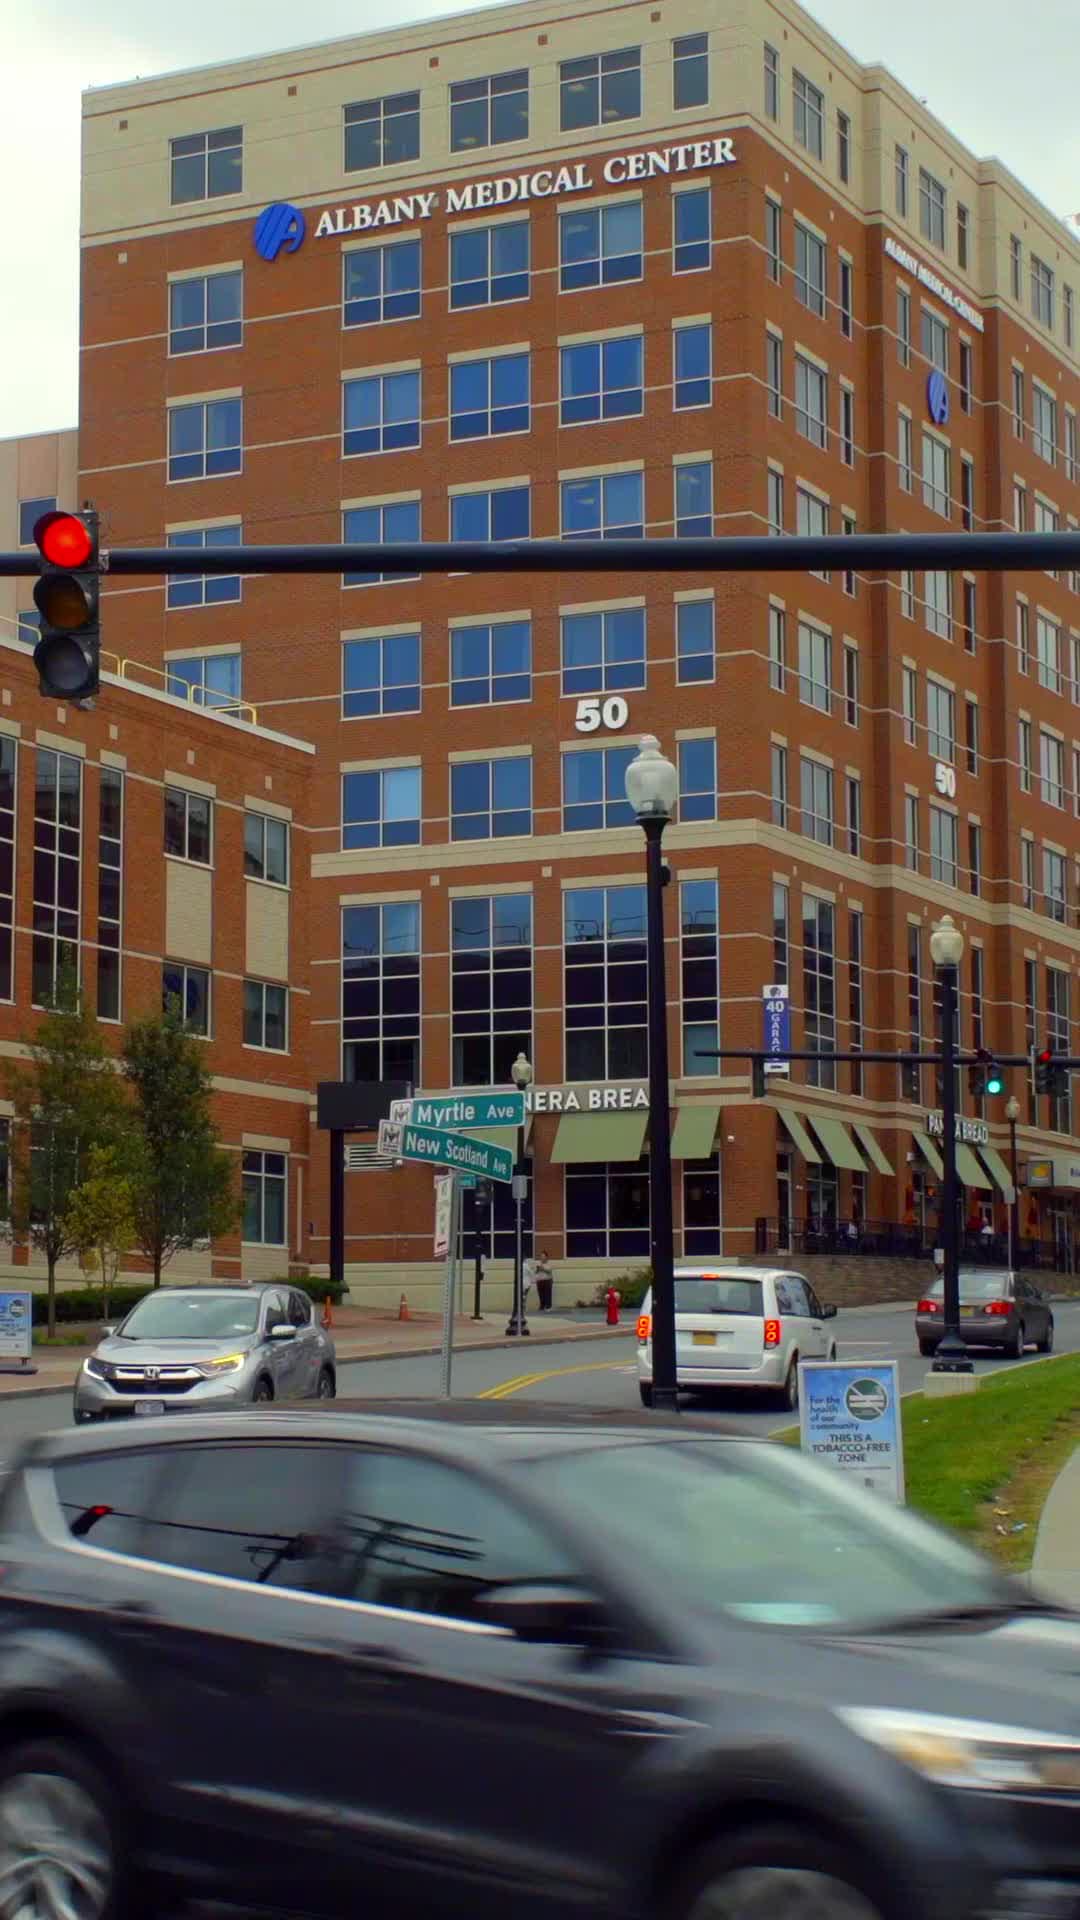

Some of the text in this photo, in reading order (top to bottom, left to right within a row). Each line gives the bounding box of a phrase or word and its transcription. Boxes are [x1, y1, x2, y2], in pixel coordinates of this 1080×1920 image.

[314, 137, 737, 238] ALBANY MEDICAL CENTER
[575, 696, 629, 732] 50
[935, 762, 956, 798] 50
[766, 1001, 785, 1013] 40
[770, 1013, 781, 1061] GARAG
[524, 1087, 650, 1111] NERA BREA
[417, 1102, 515, 1127] Myrtle Ave
[962, 1121, 989, 1143] BREAD
[406, 1132, 507, 1174] New Scotland Ave
[812, 1443, 891, 1453] TOBACCO-FREE
[830, 1433, 872, 1442] THIS IS A
[838, 1453, 866, 1463] ZONE
